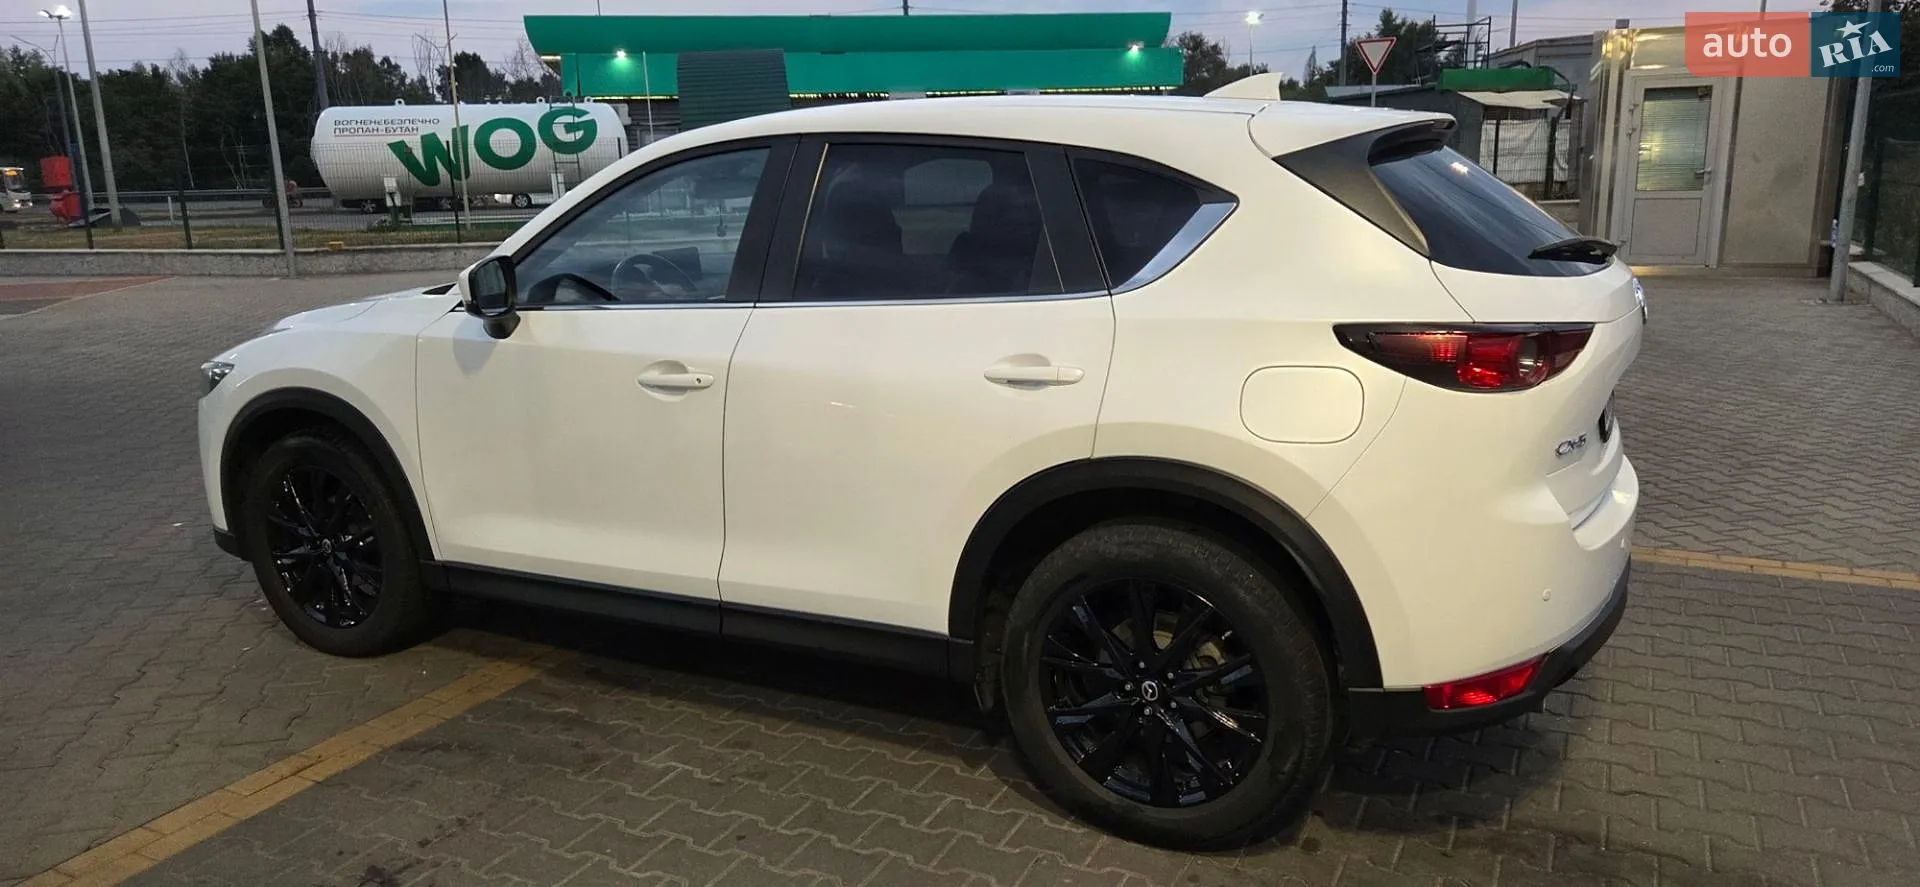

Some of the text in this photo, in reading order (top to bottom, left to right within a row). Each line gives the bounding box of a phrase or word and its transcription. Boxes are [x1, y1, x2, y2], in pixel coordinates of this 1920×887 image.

[334, 118, 440, 126] ВОГНЕНЕБЕЗПЕЧНО
[387, 107, 598, 187] WOG
[1555, 433, 1587, 456] CX-5
